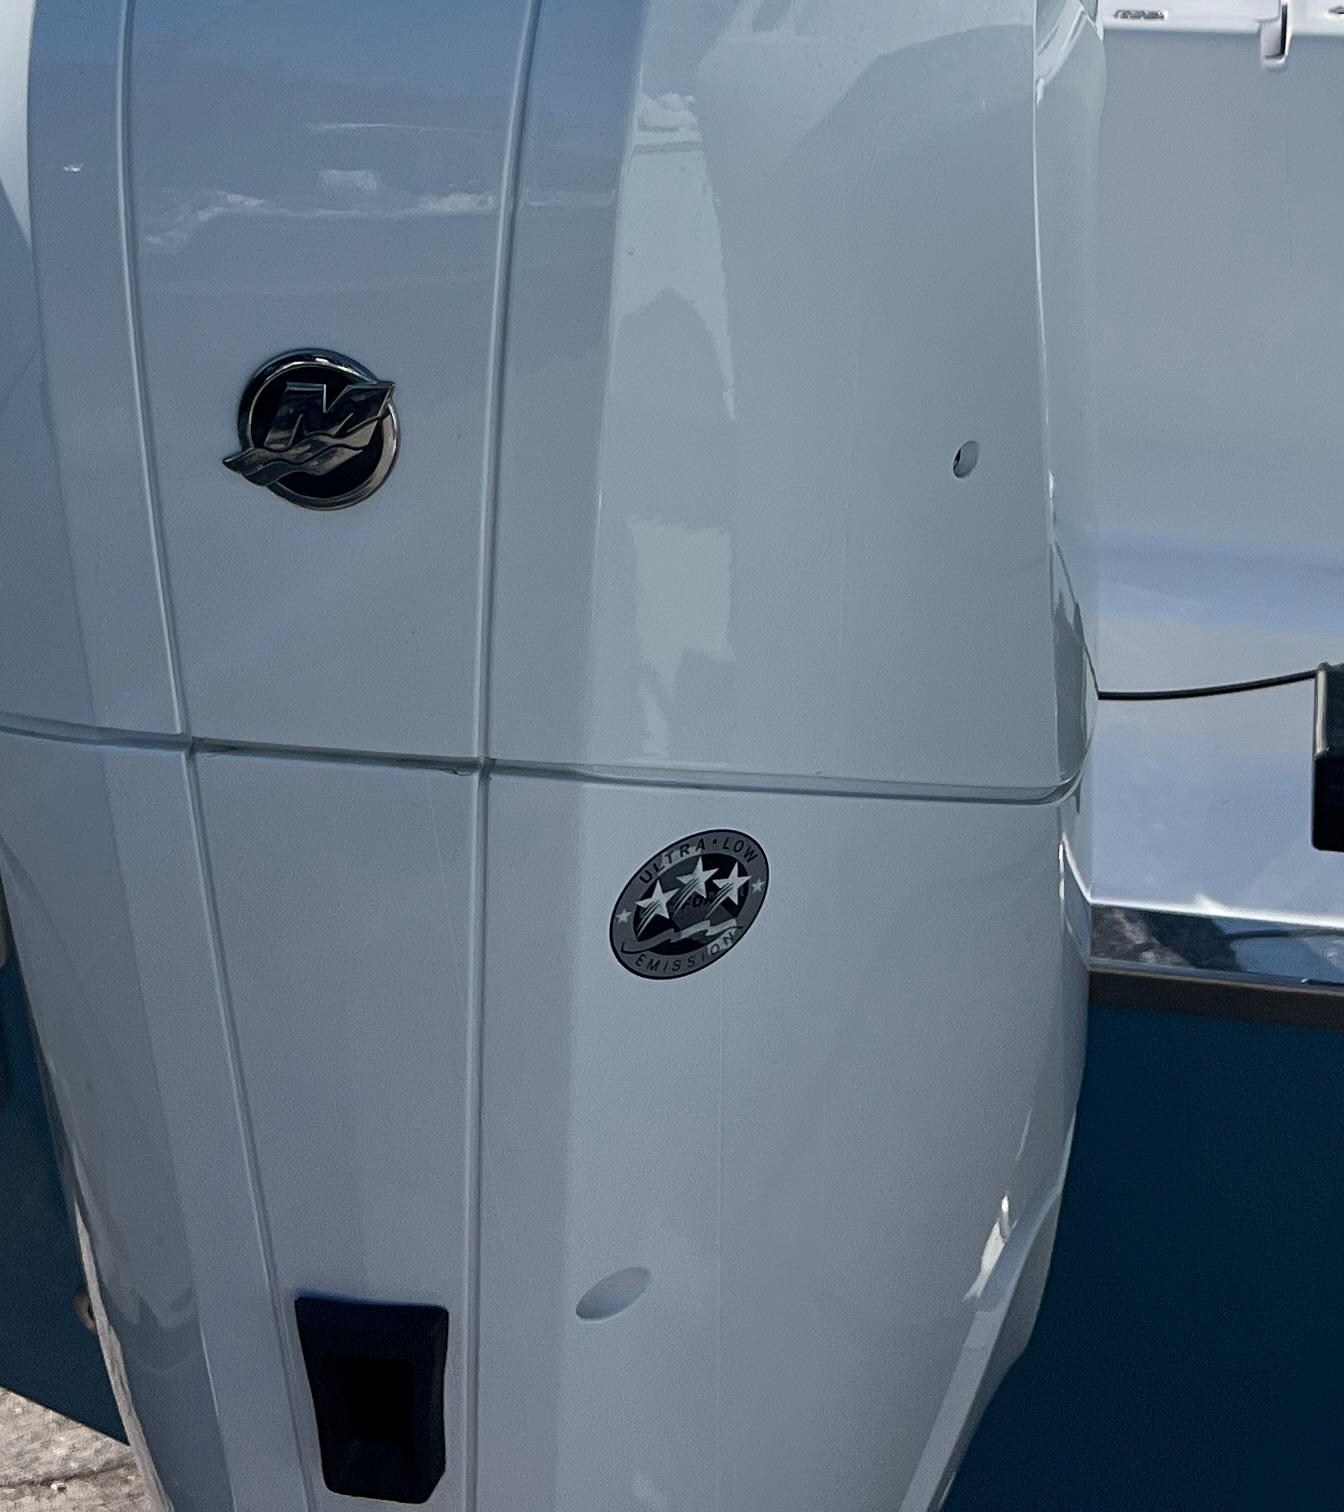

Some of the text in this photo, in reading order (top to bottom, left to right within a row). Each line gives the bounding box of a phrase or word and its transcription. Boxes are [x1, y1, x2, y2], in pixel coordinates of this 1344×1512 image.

[640, 837, 758, 884] ULTRA LOW
[635, 931, 736, 973] EMISSION
